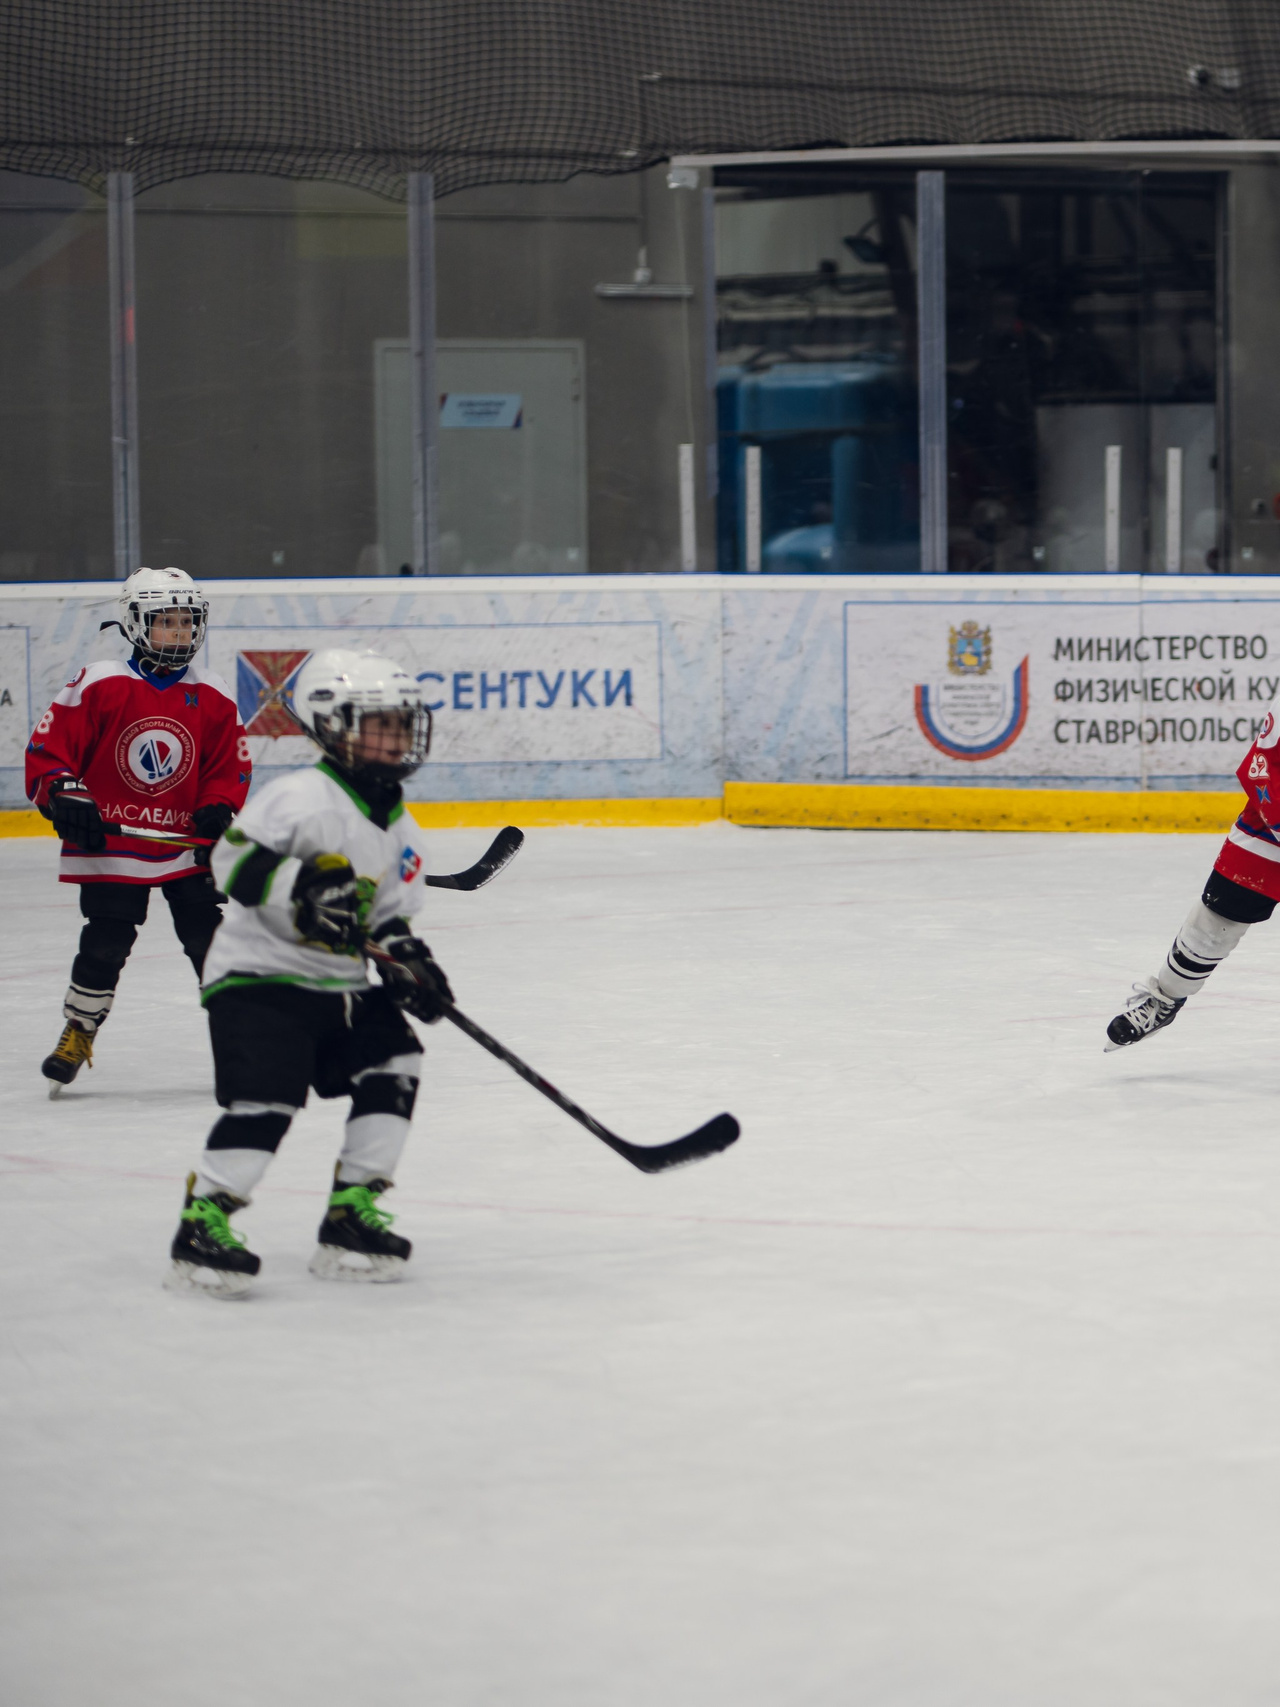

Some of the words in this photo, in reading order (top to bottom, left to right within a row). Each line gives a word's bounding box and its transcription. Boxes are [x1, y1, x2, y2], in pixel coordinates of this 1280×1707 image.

[1053, 635, 1267, 661] МИНИСТЕРСТВО
[416, 668, 633, 711] СЕНТУКИ
[1054, 668, 1235, 703] ФИЗИЧЕСКОЙ
[139, 720, 164, 730] СПОРТА
[1053, 716, 1264, 744] СТАВРОПОЛЬСК
[1248, 753, 1270, 780] 82
